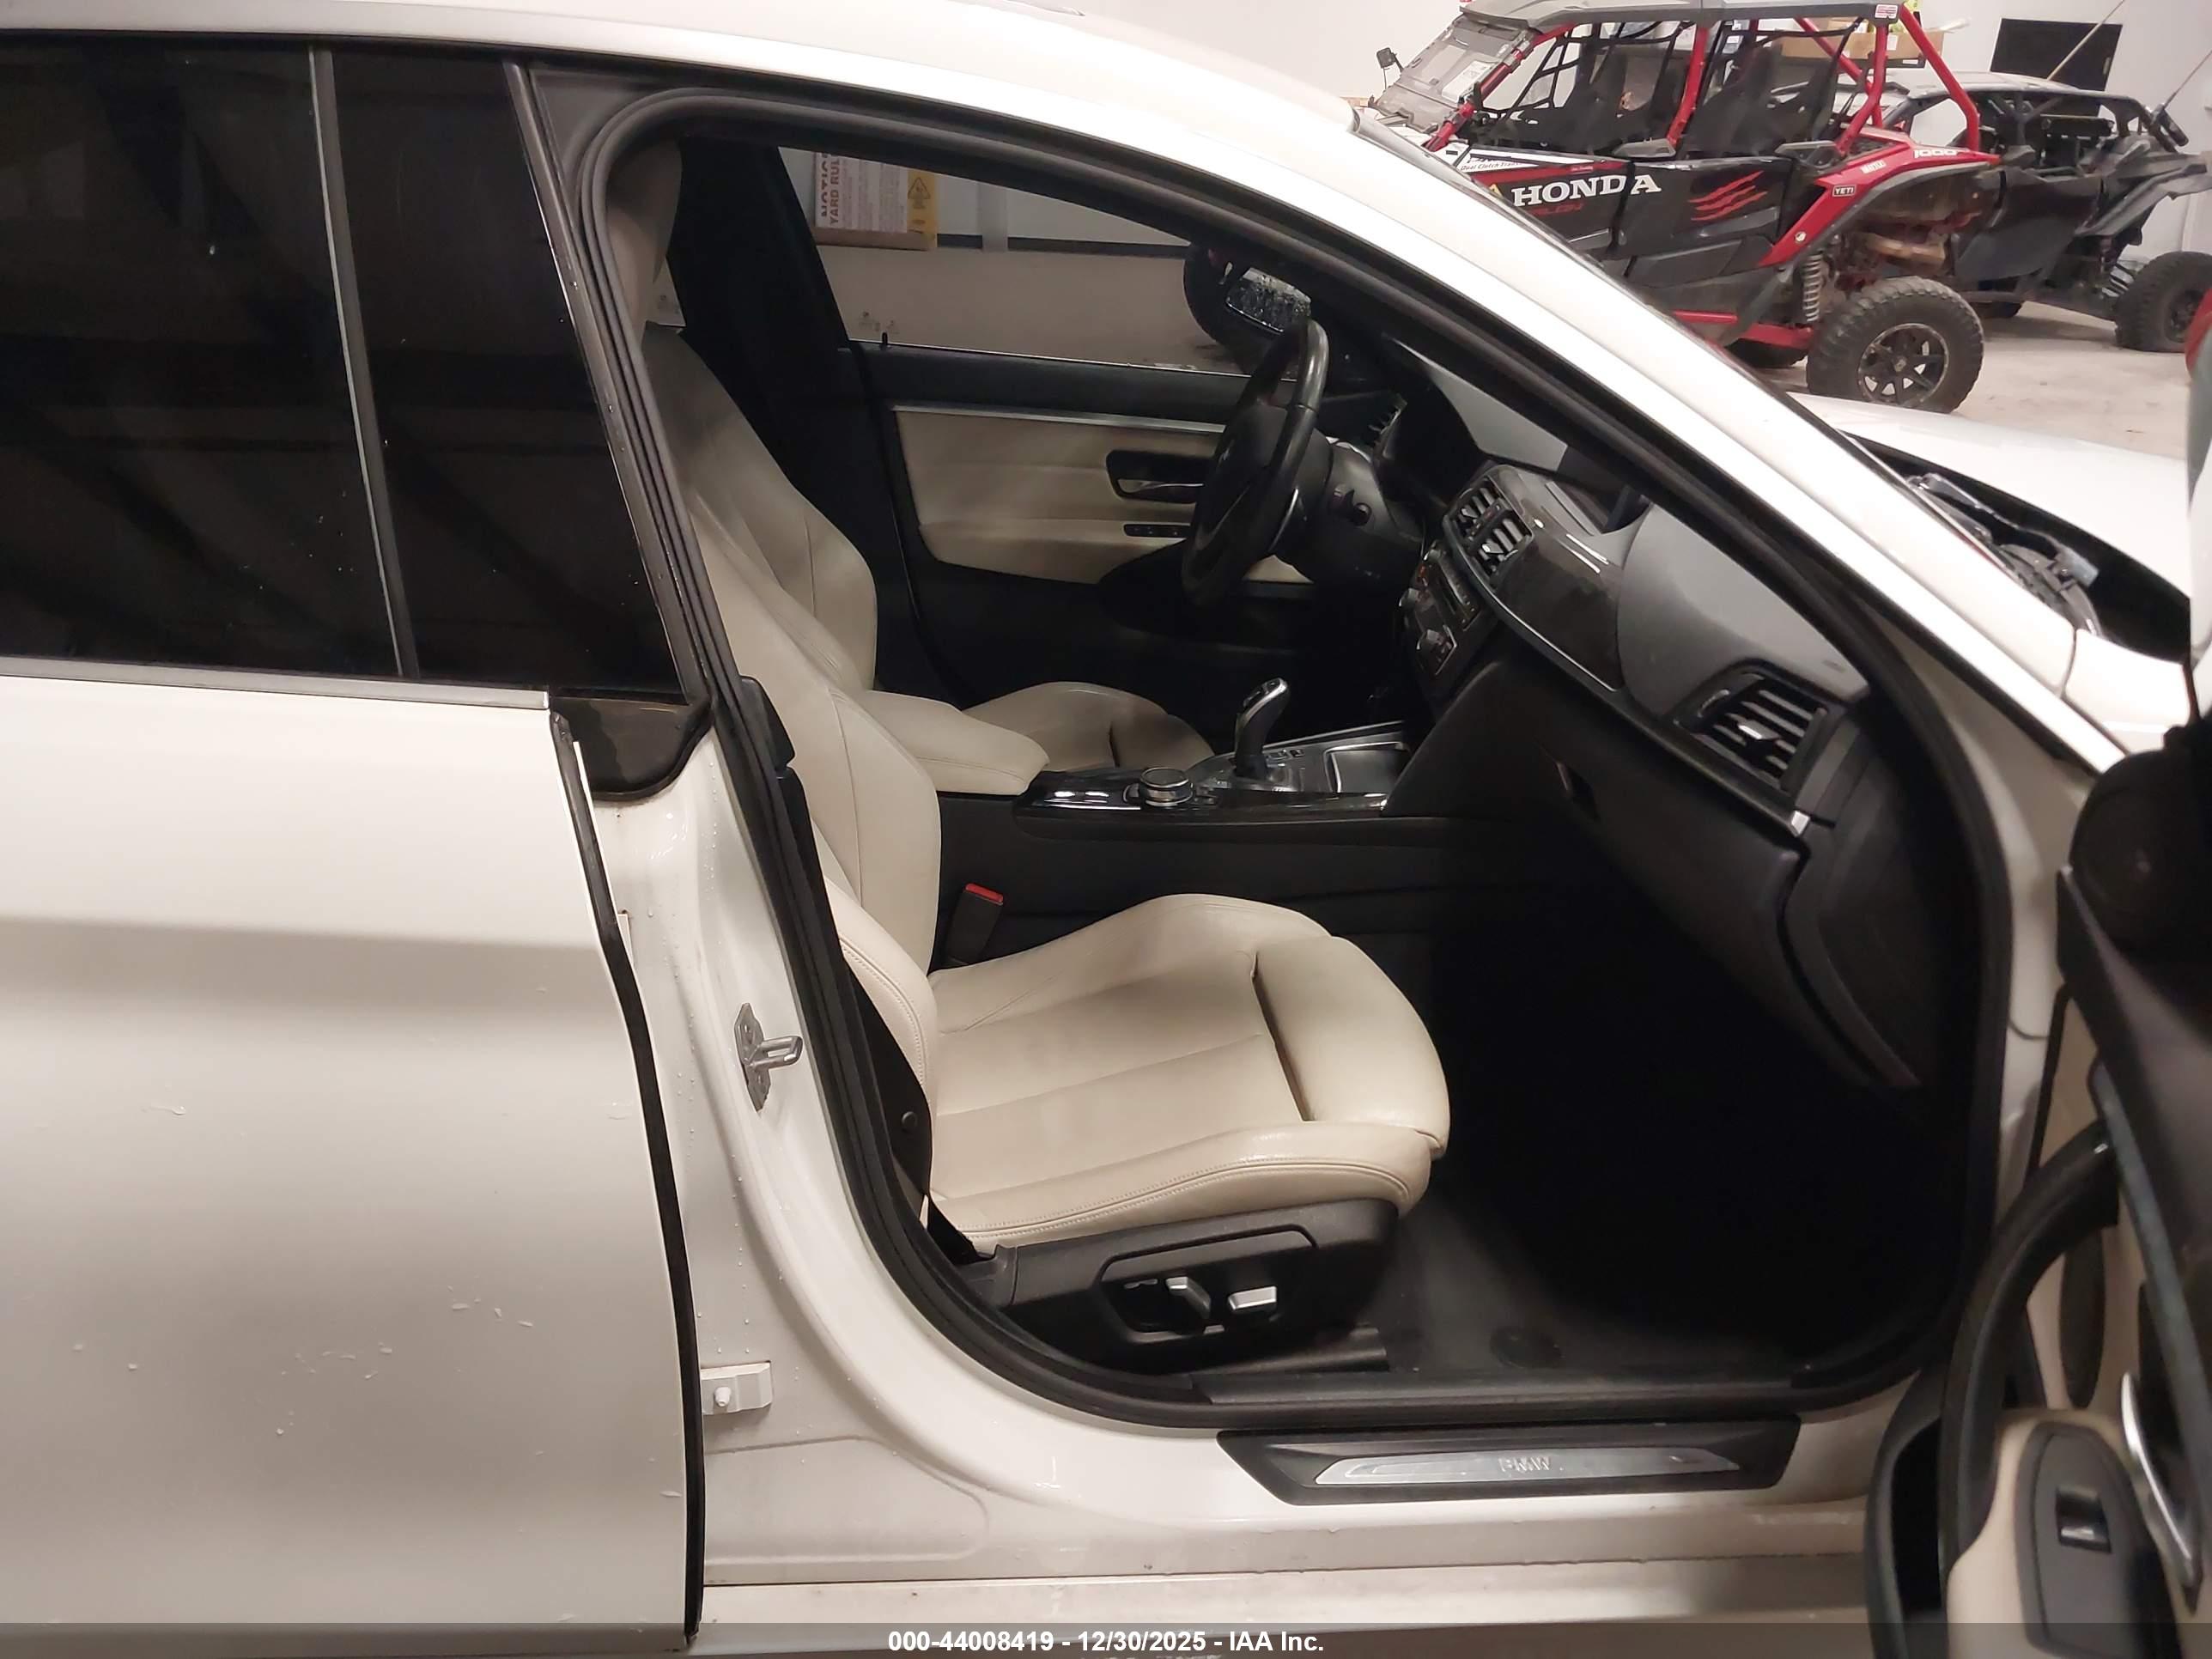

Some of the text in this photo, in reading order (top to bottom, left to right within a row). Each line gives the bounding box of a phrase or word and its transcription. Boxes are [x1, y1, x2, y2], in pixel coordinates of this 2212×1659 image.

[1914, 149, 1957, 159] 1000
[830, 157, 840, 224] YARD RUL
[1511, 174, 1662, 207] HONDA
[1834, 186, 1854, 195] YETI
[1498, 1456, 1551, 1472] BMW
